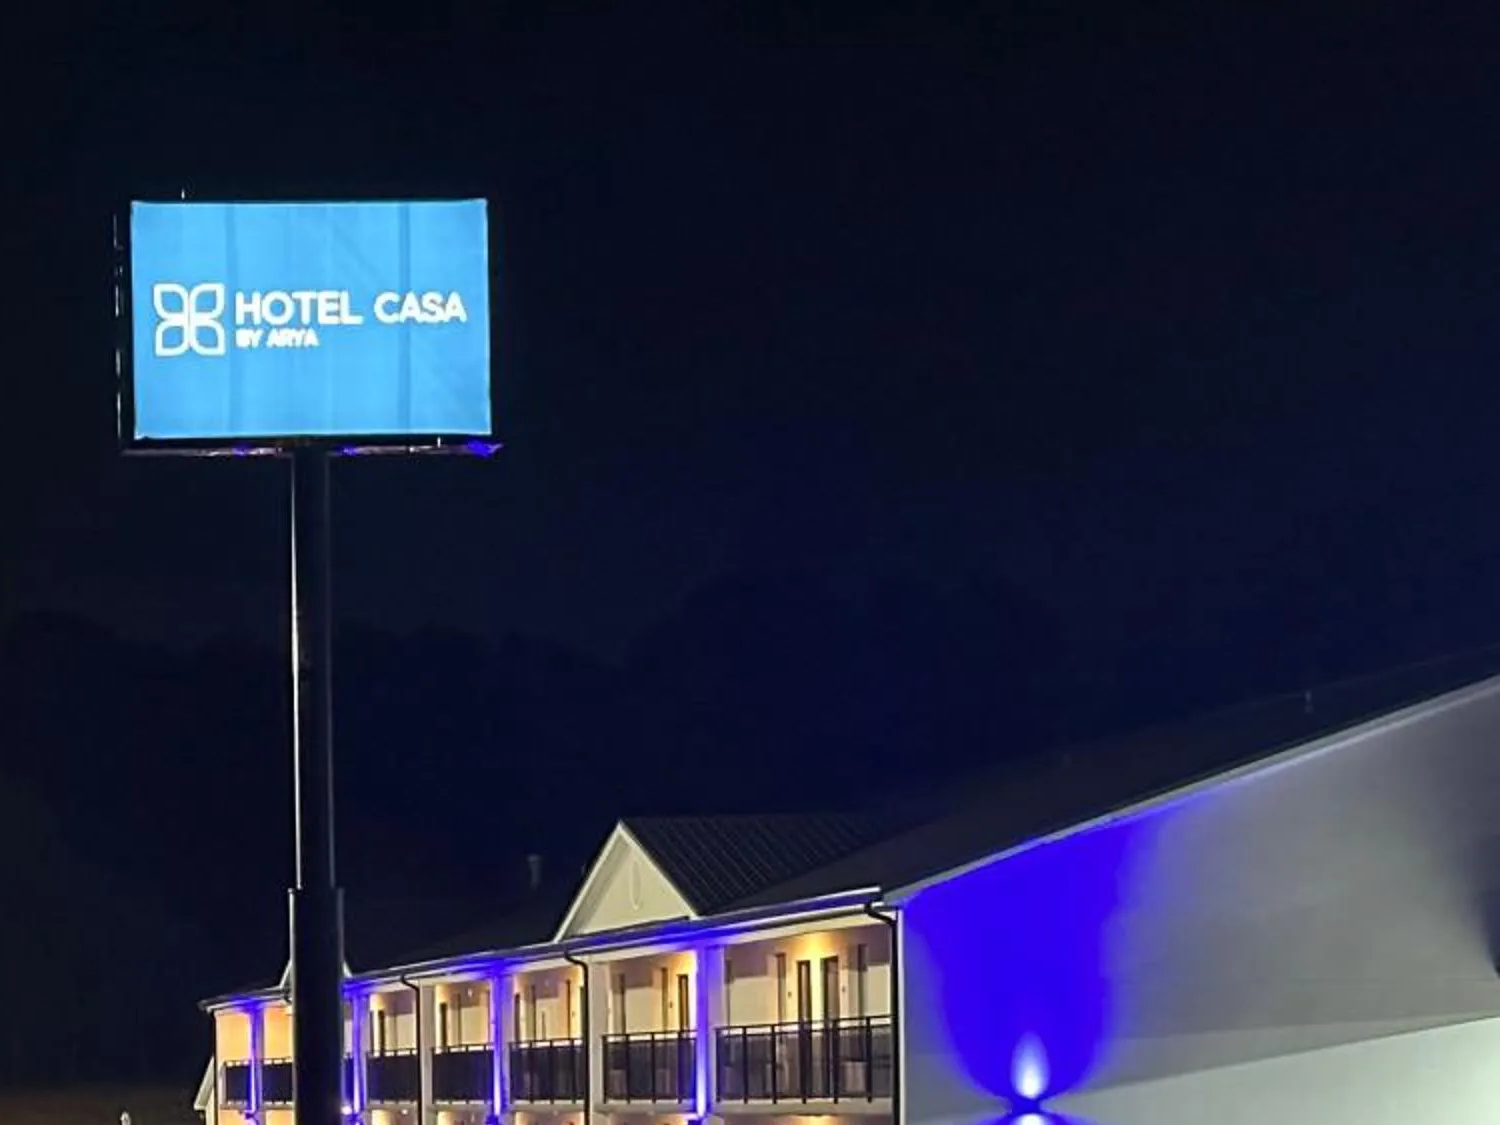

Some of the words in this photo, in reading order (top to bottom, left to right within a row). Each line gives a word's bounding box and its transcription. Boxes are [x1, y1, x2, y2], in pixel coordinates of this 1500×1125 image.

[235, 291, 364, 326] HOTEL
[373, 291, 468, 324] CASA
[235, 329, 264, 348] BY
[266, 329, 319, 348] ARYA
